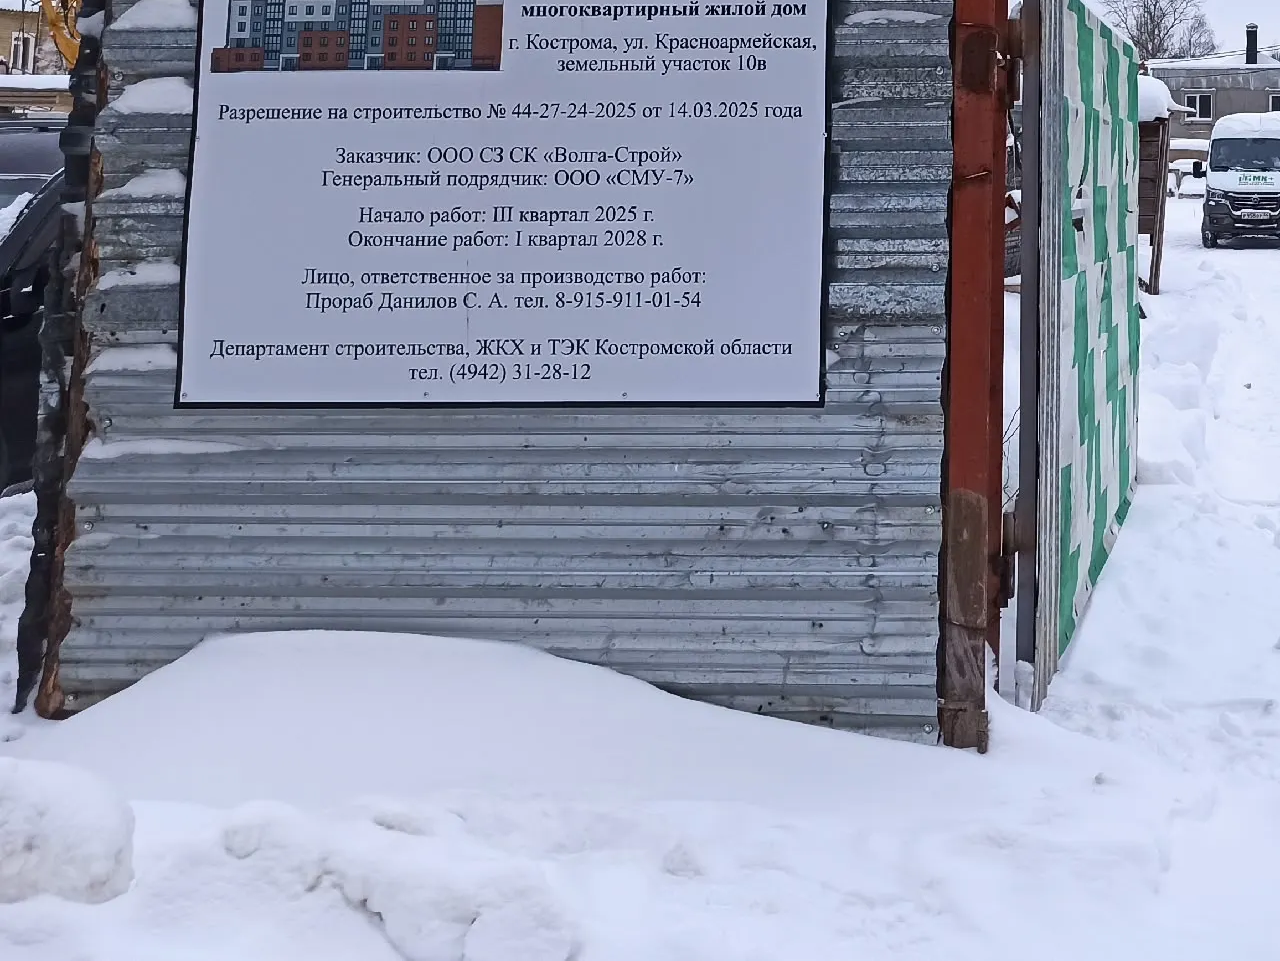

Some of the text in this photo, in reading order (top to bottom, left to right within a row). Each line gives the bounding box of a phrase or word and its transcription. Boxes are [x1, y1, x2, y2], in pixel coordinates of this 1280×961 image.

[521, 0, 807, 21] многоквартирный жилой дом
[508, 32, 817, 55] г. Кострома, ул. Красноармейская,
[557, 54, 767, 76] земельный участок 10в
[218, 101, 803, 125] Разрешение на строительство № 44-27-24-2025 от 14.03.2025 года
[335, 146, 683, 168] Заказчик: ООО СЗ СК «Волга-Строй»
[321, 168, 694, 191] Генеральный подрядчик: ООО «СМУ-7»
[358, 205, 654, 228] Начало работ: III квартал 2025 г.
[348, 229, 664, 252] Окончание работ: I квартал 2028 г.
[301, 266, 706, 289] Лицо, ответственное за производство работ:
[305, 291, 702, 314] Прораб Данилов С. А. тел. 8-915-911-01-54
[209, 338, 793, 361] Департамент строительства, ЖКХ и ТЭК Костромской области
[408, 362, 591, 385] тел. (4942) 31-28-12
